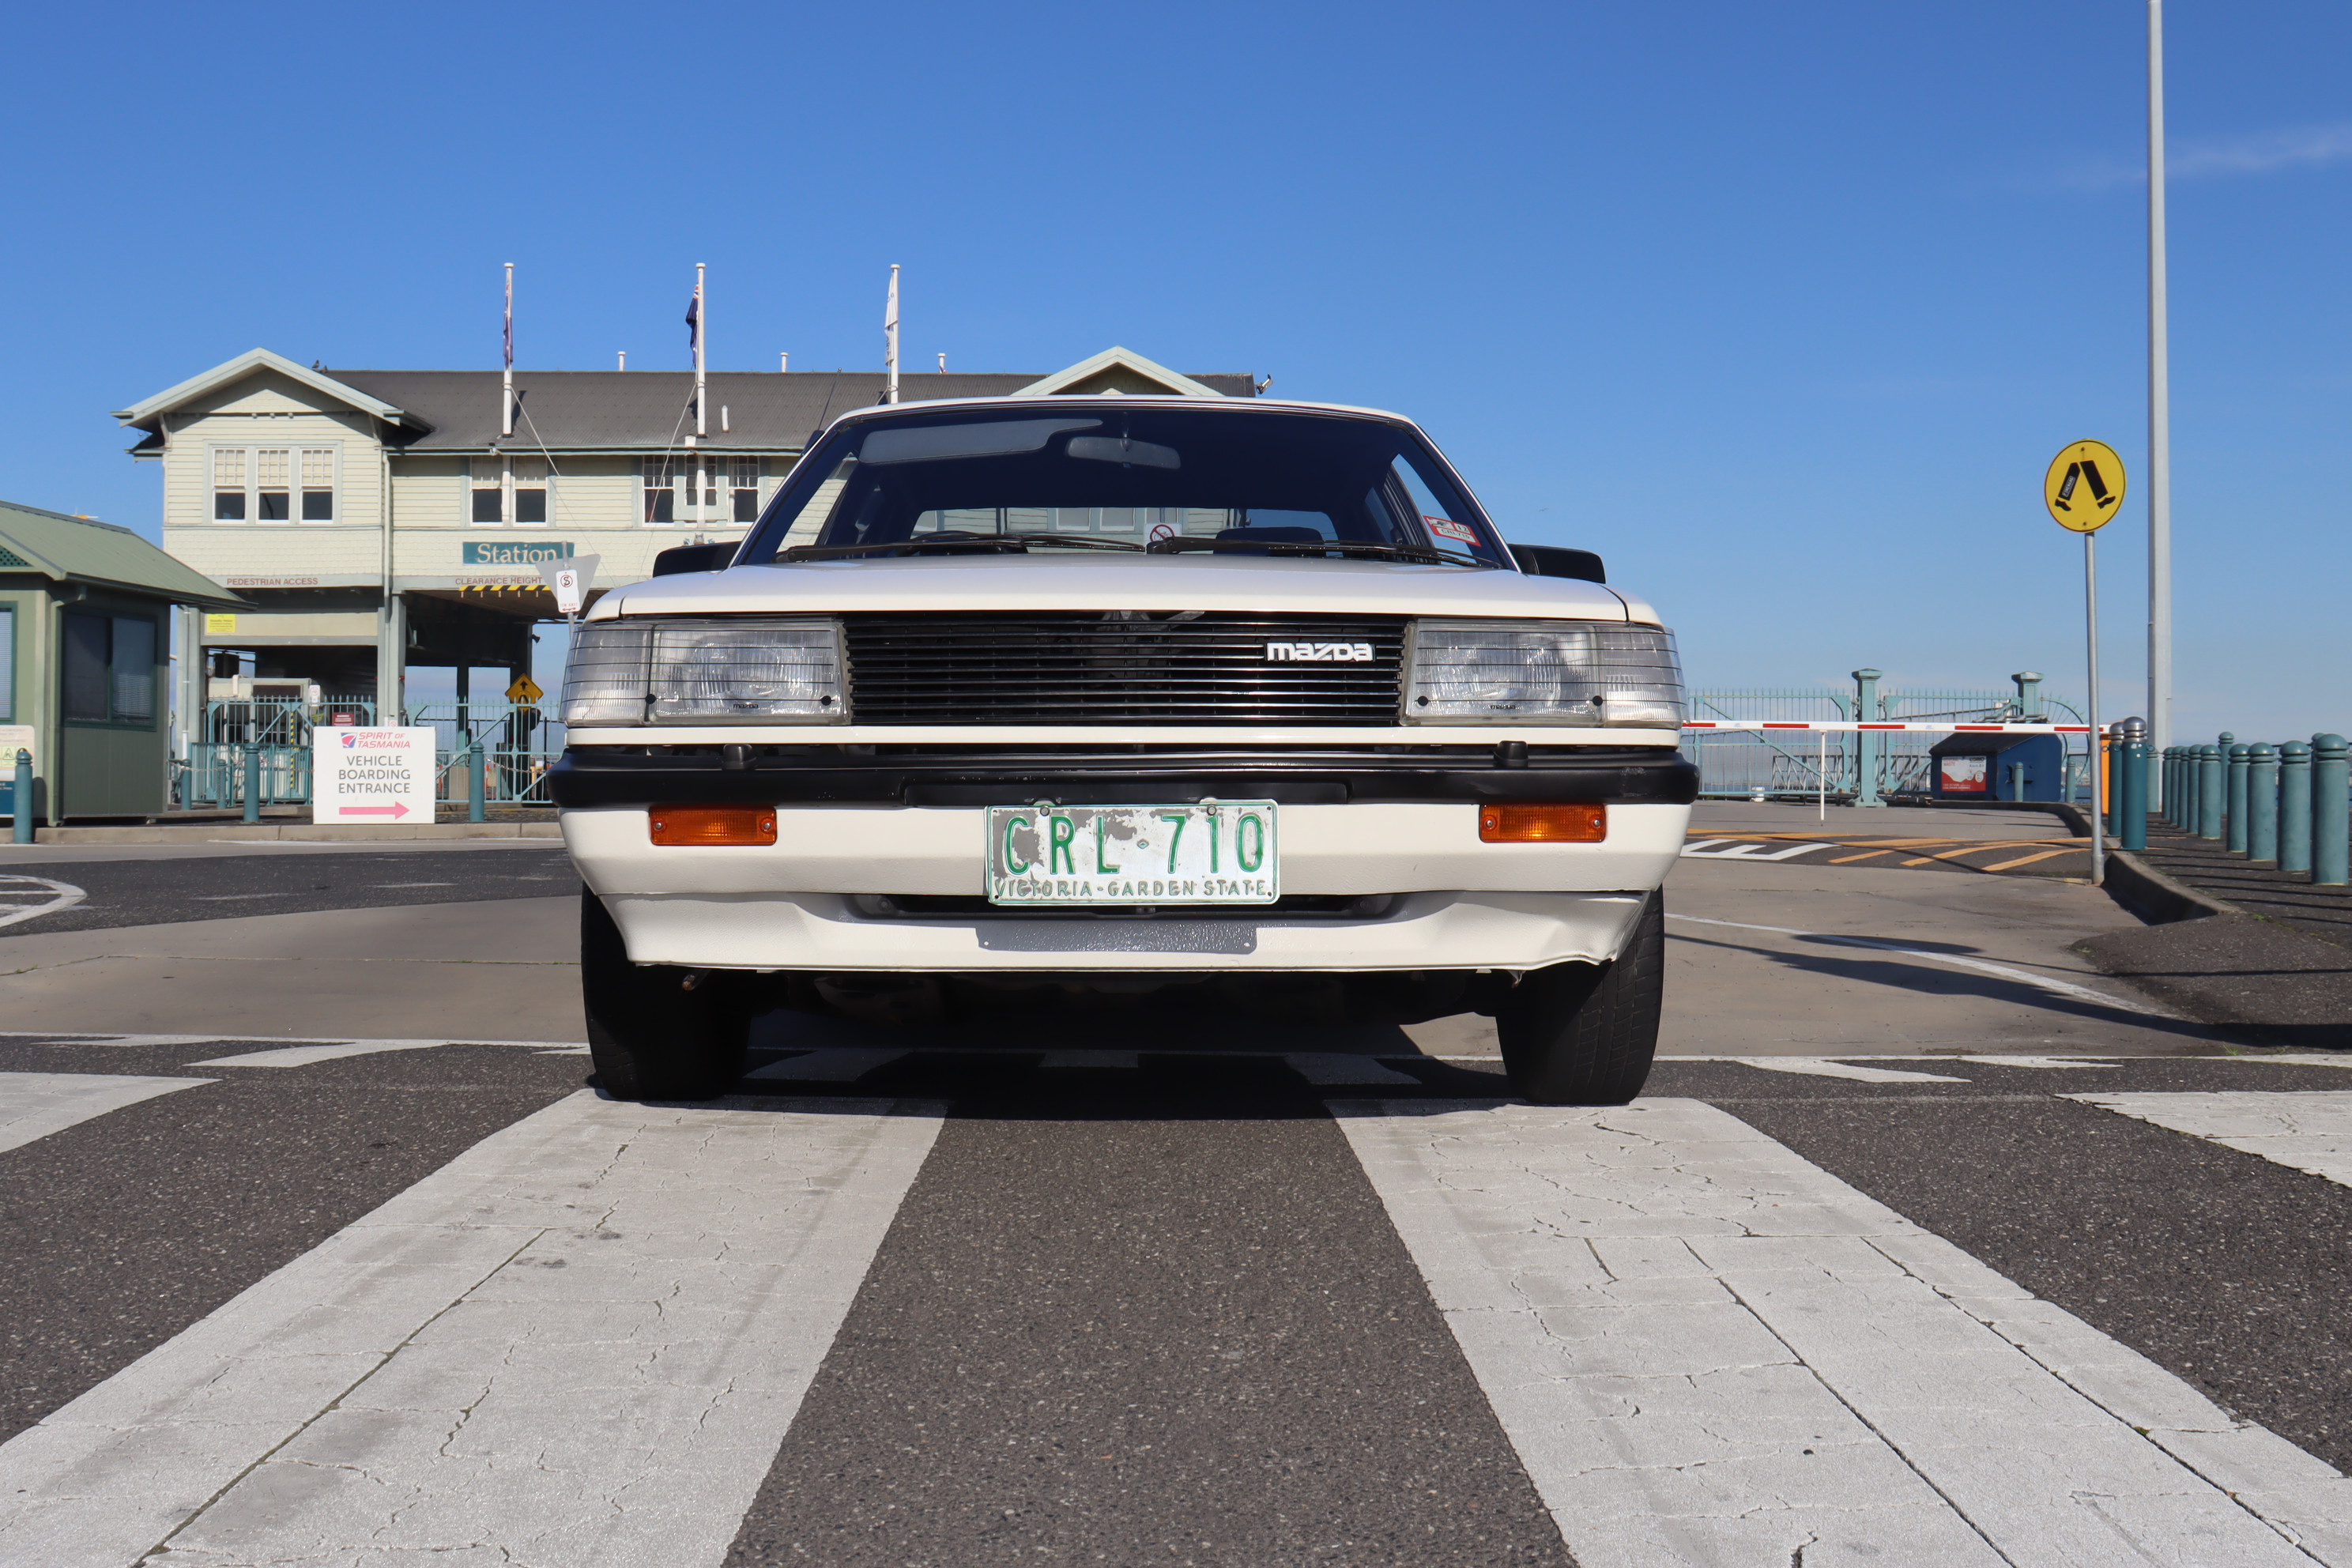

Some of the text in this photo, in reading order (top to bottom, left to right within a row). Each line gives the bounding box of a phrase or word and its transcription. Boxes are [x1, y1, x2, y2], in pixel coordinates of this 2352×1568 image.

[477, 544, 556, 564] Station
[346, 756, 402, 766] VEHICLE
[338, 769, 411, 780] BOARDING
[338, 782, 411, 793] ENTRANCE
[1005, 814, 1265, 875] CRL 710
[1204, 880, 1266, 896] STATE
